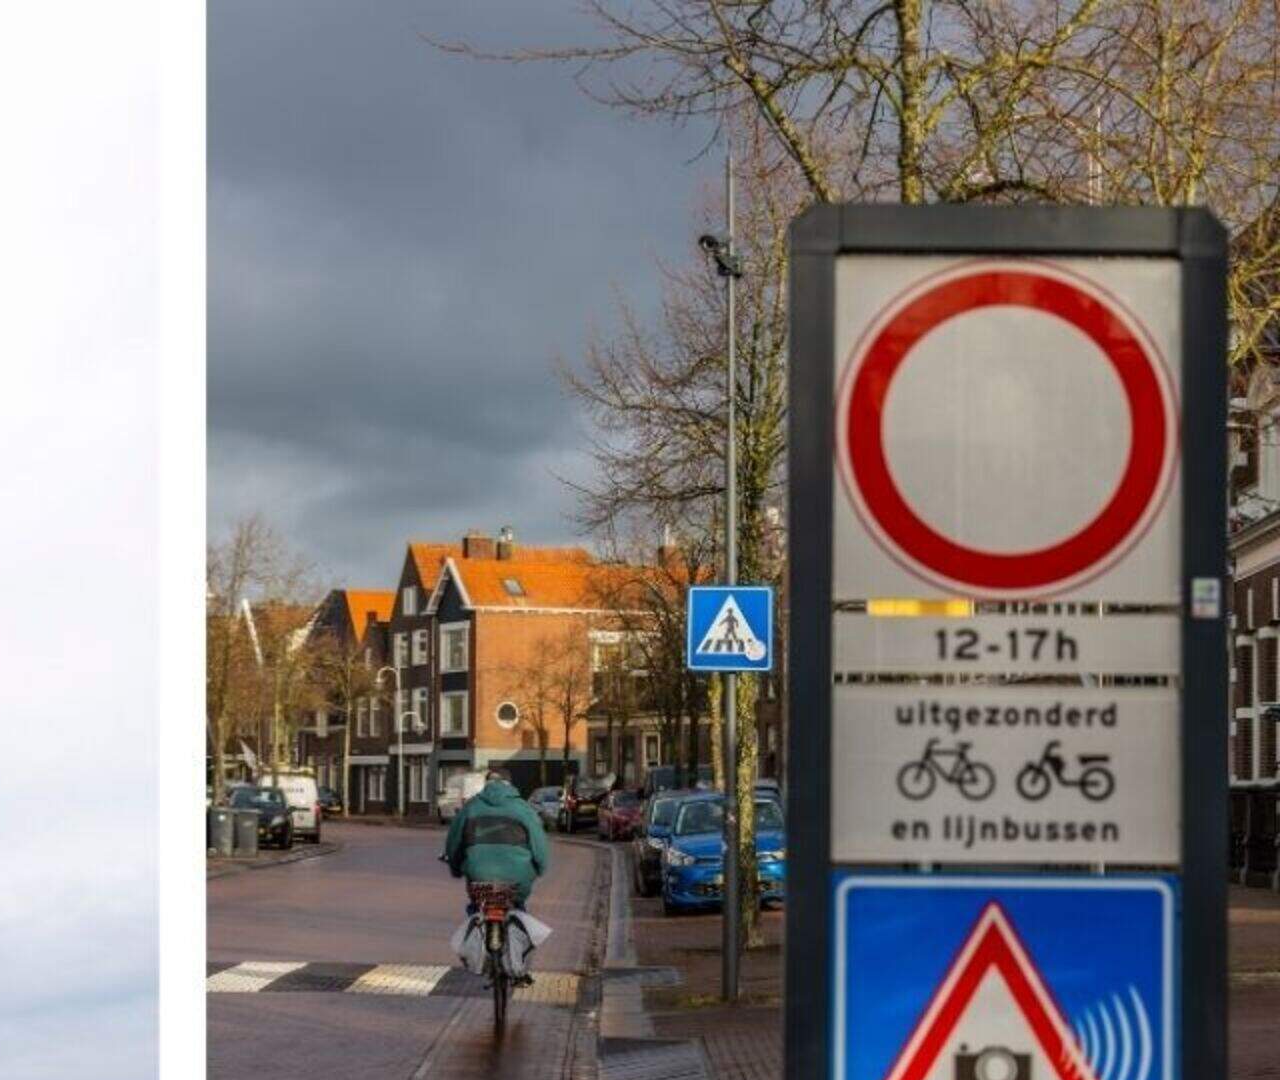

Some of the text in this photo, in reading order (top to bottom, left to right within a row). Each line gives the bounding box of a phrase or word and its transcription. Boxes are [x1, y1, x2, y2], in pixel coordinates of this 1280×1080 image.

[934, 627, 1079, 661] 12-17h
[895, 700, 1118, 734] uitgezonderd
[892, 814, 1120, 849] en lijnbussen
